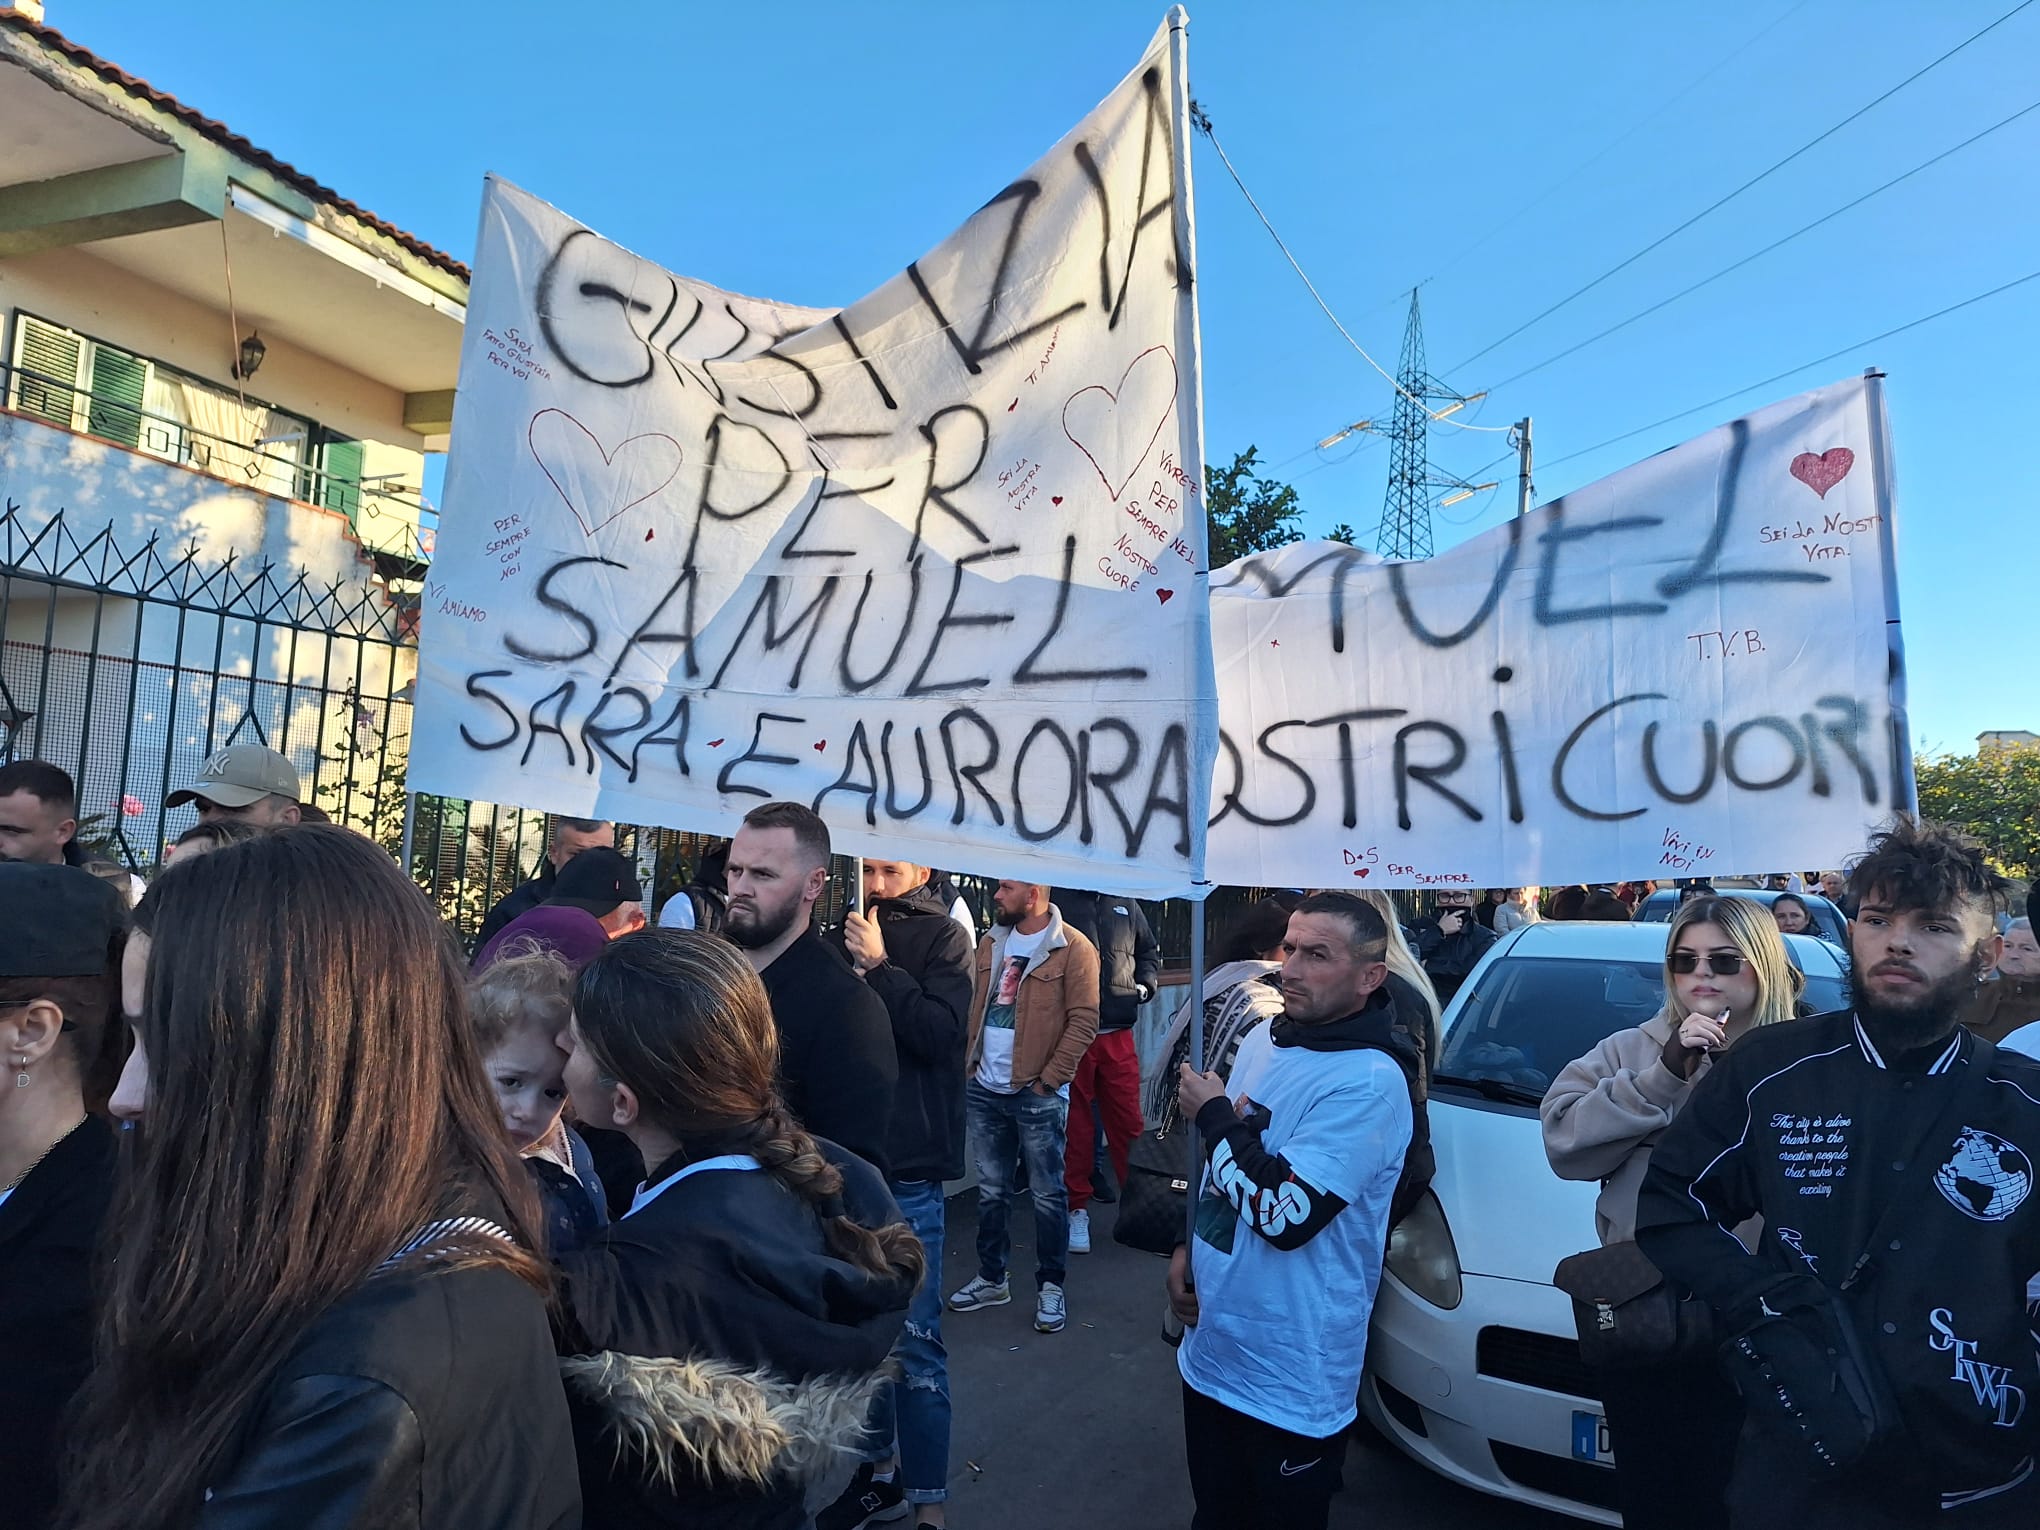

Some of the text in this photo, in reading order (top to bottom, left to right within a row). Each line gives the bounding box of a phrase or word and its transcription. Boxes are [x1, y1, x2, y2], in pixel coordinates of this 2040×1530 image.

[488, 351, 509, 370] PER
[684, 404, 990, 567] PER
[1008, 463, 1041, 502] NOSTRA
[1014, 485, 1038, 511] VITA
[1148, 480, 1178, 516] PER
[494, 513, 521, 534] PER
[1126, 500, 1195, 565] SEMPRE NEL
[484, 527, 531, 556] SEMPRE
[500, 547, 521, 564] CON
[1113, 532, 1158, 576] NOSTRO
[1098, 556, 1140, 592] CUORE
[504, 535, 1148, 698] SAMUEL
[460, 670, 1191, 858] SARA E AURORA
[1387, 864, 1415, 877] PER
[1770, 1113, 1795, 1129] The
[1812, 1134, 1824, 1144] to
[1826, 1129, 1845, 1144] the
[1813, 1145, 1849, 1165] people
[1784, 1163, 1806, 1178] that
[1835, 1165, 1847, 1177] it
[1928, 1307, 2026, 1428] STWD
